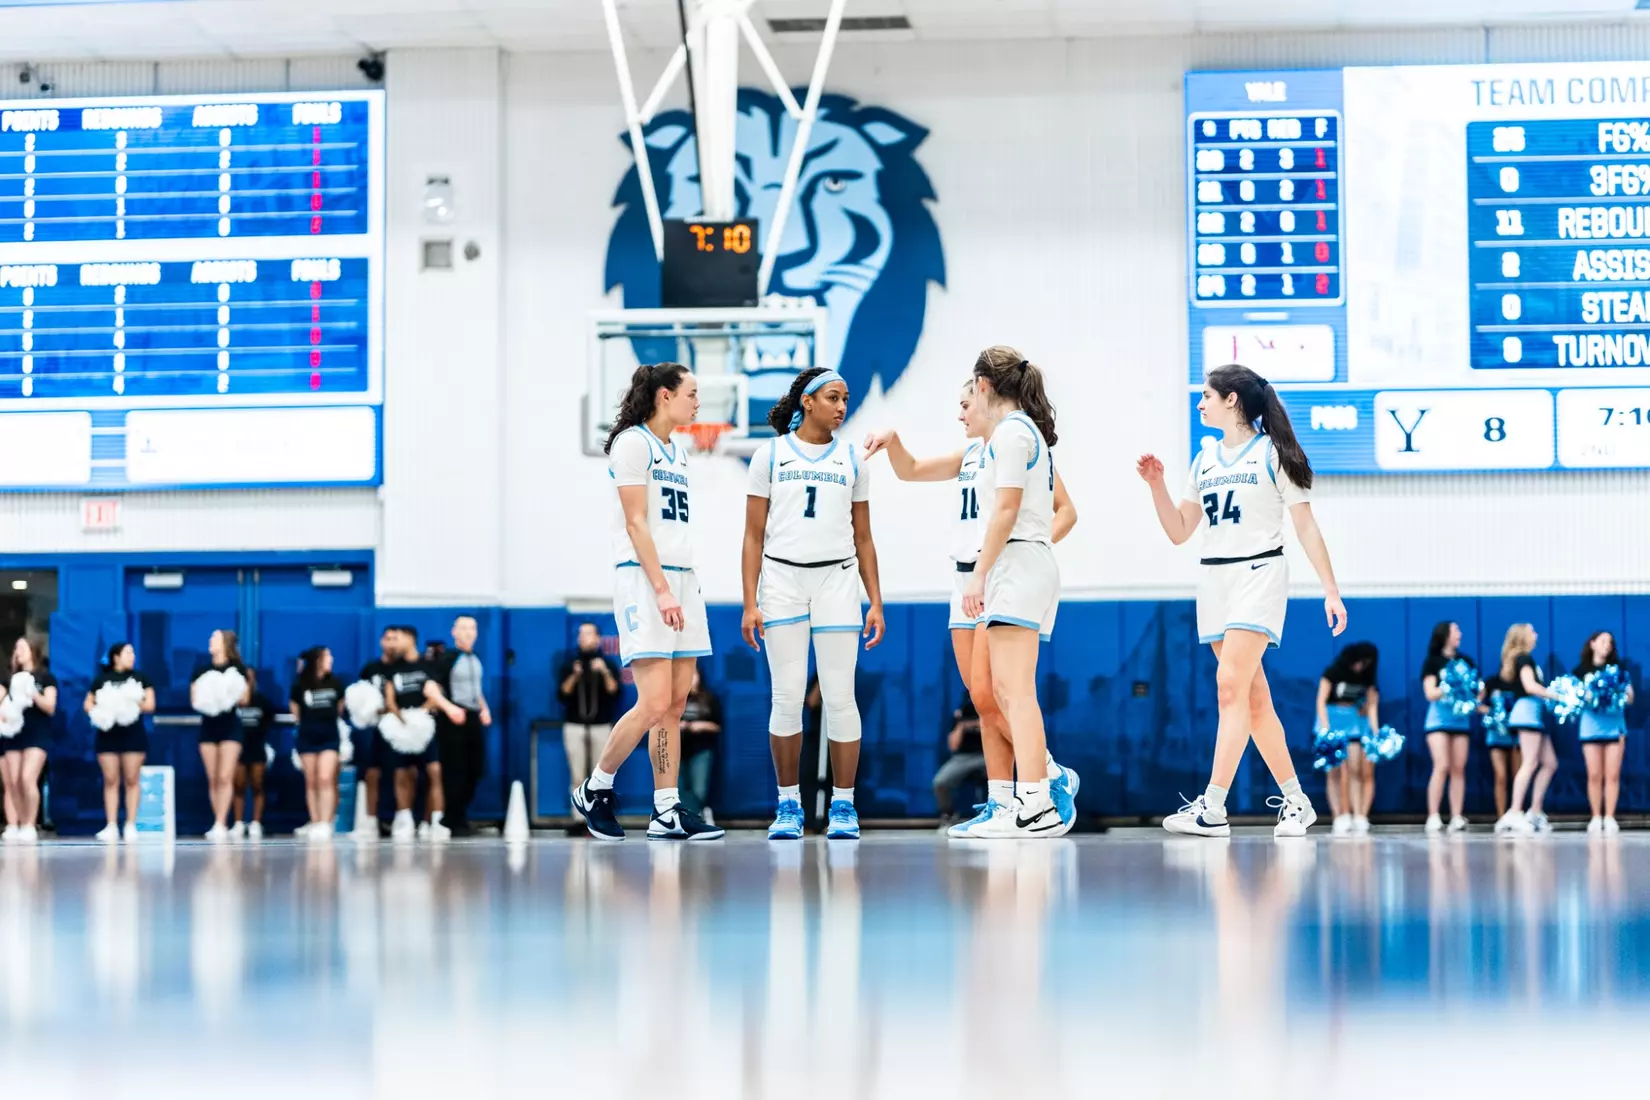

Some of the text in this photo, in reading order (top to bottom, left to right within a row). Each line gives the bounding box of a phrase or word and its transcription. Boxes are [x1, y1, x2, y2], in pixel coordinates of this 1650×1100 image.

[1471, 79, 1555, 106] TEAM
[1315, 147, 1326, 168] 1
[1315, 179, 1326, 200] 1
[1316, 210, 1327, 231] 1
[690, 224, 751, 254] 7:10
[1316, 273, 1329, 294] 2
[1599, 407, 1650, 426] 7:1
[1386, 408, 1430, 453] Y
[1483, 417, 1507, 442] 8
[778, 470, 847, 486] COLUMBIA
[661, 486, 689, 524] 35
[803, 486, 817, 519] 1
[1202, 490, 1242, 528] 24
